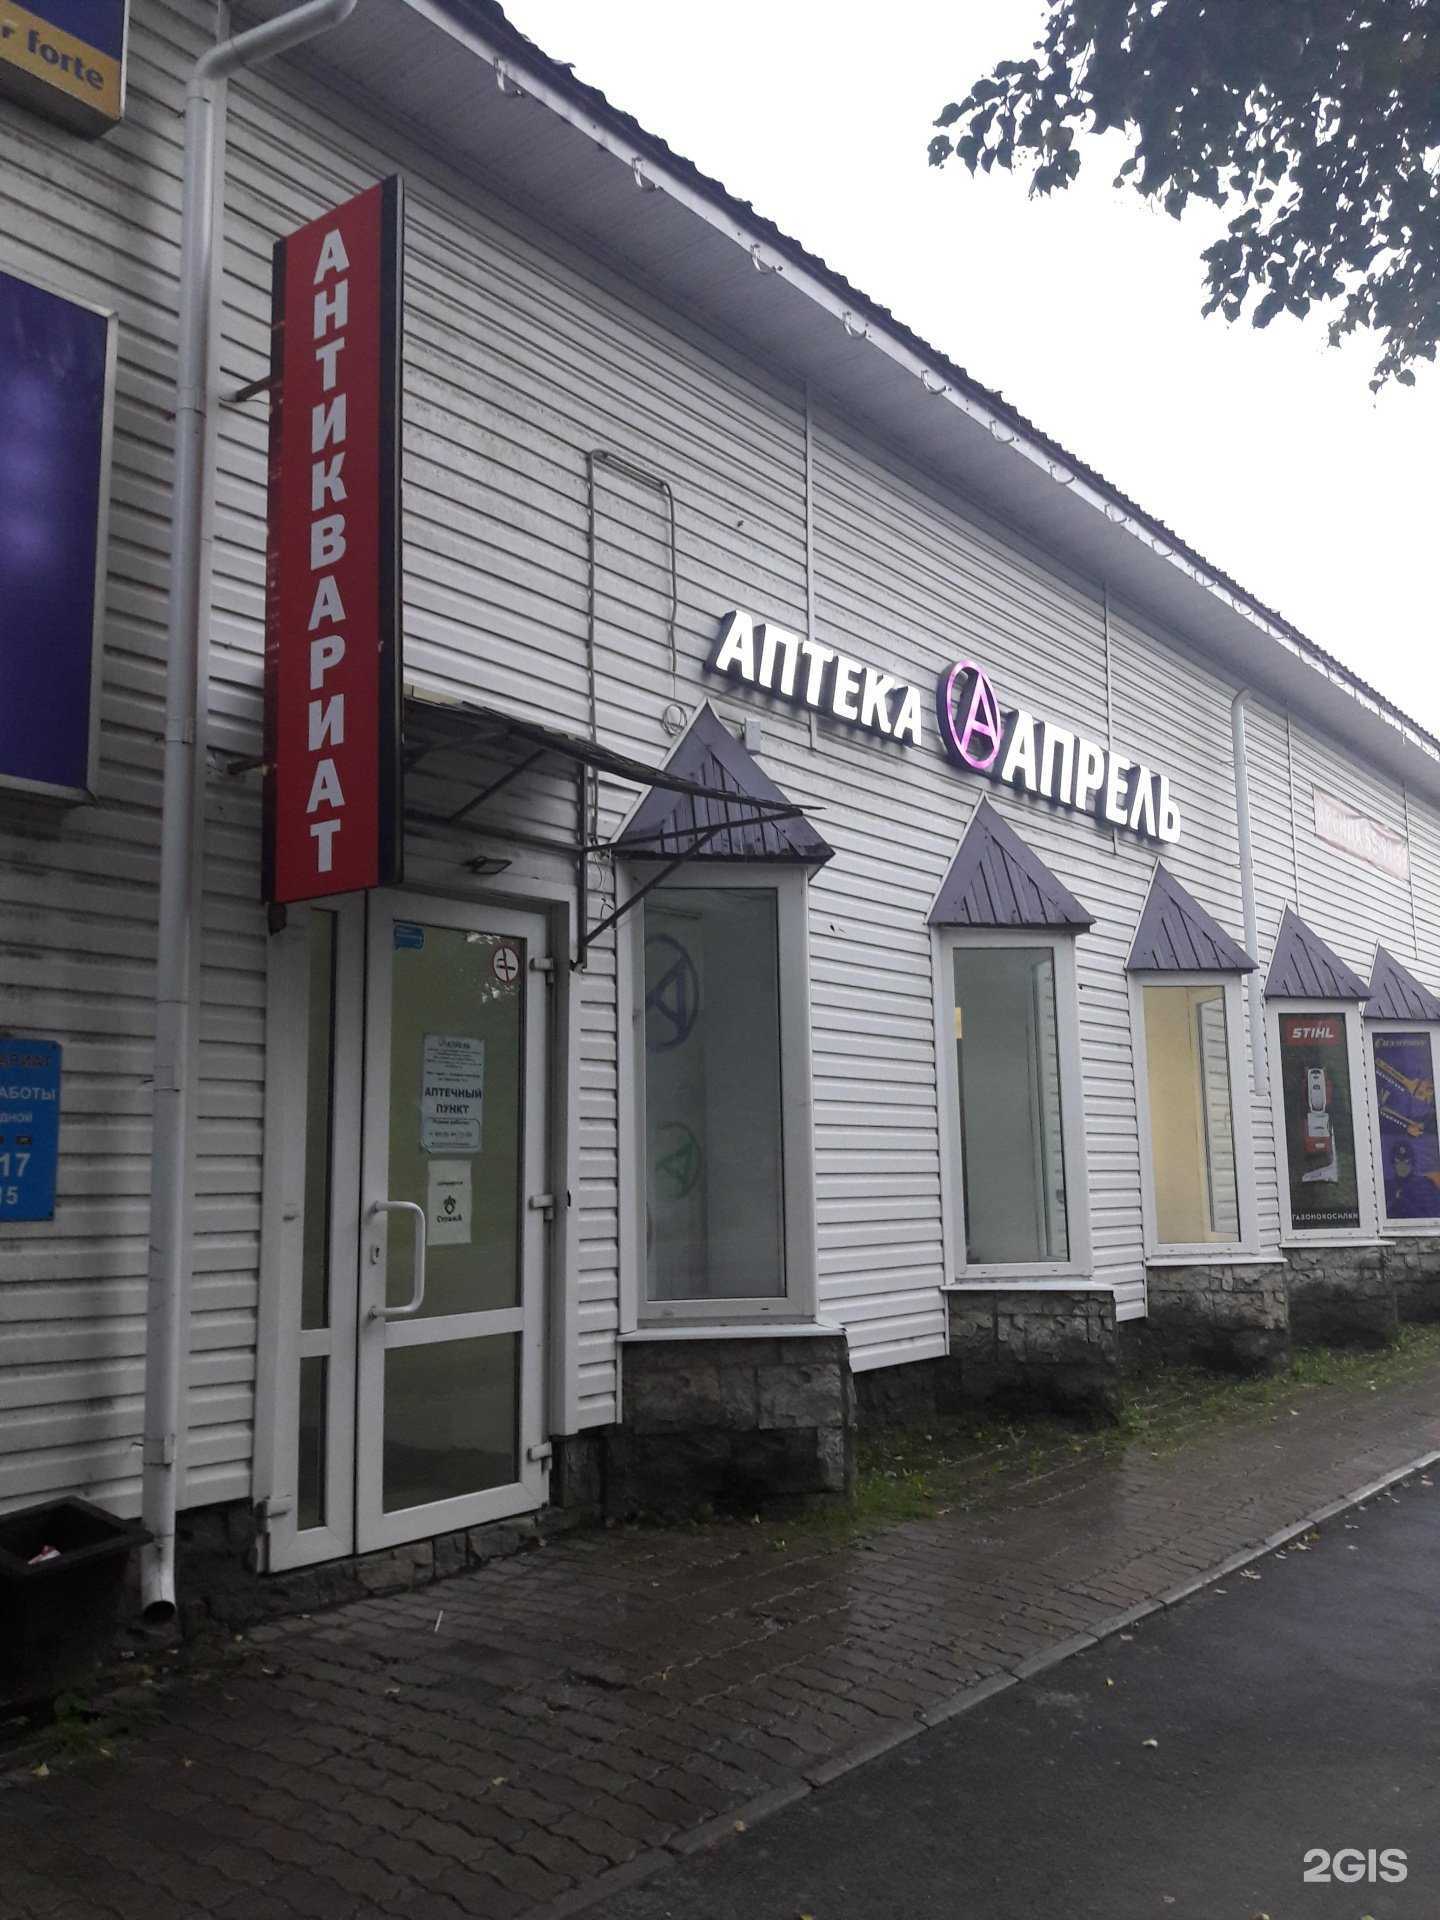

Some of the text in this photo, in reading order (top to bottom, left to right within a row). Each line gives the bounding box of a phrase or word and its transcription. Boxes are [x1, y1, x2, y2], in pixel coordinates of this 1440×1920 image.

[27, 29, 104, 90] forte
[306, 228, 350, 873] АНТИКВАРИАТ
[715, 609, 923, 746] АПТЕКА
[1001, 709, 1182, 843] АПРЕЛЬ
[1292, 1027, 1335, 1039] STIHL
[424, 1087, 482, 1099] АПТЕЧНЫЙ
[436, 1104, 469, 1114] ПУНКТ
